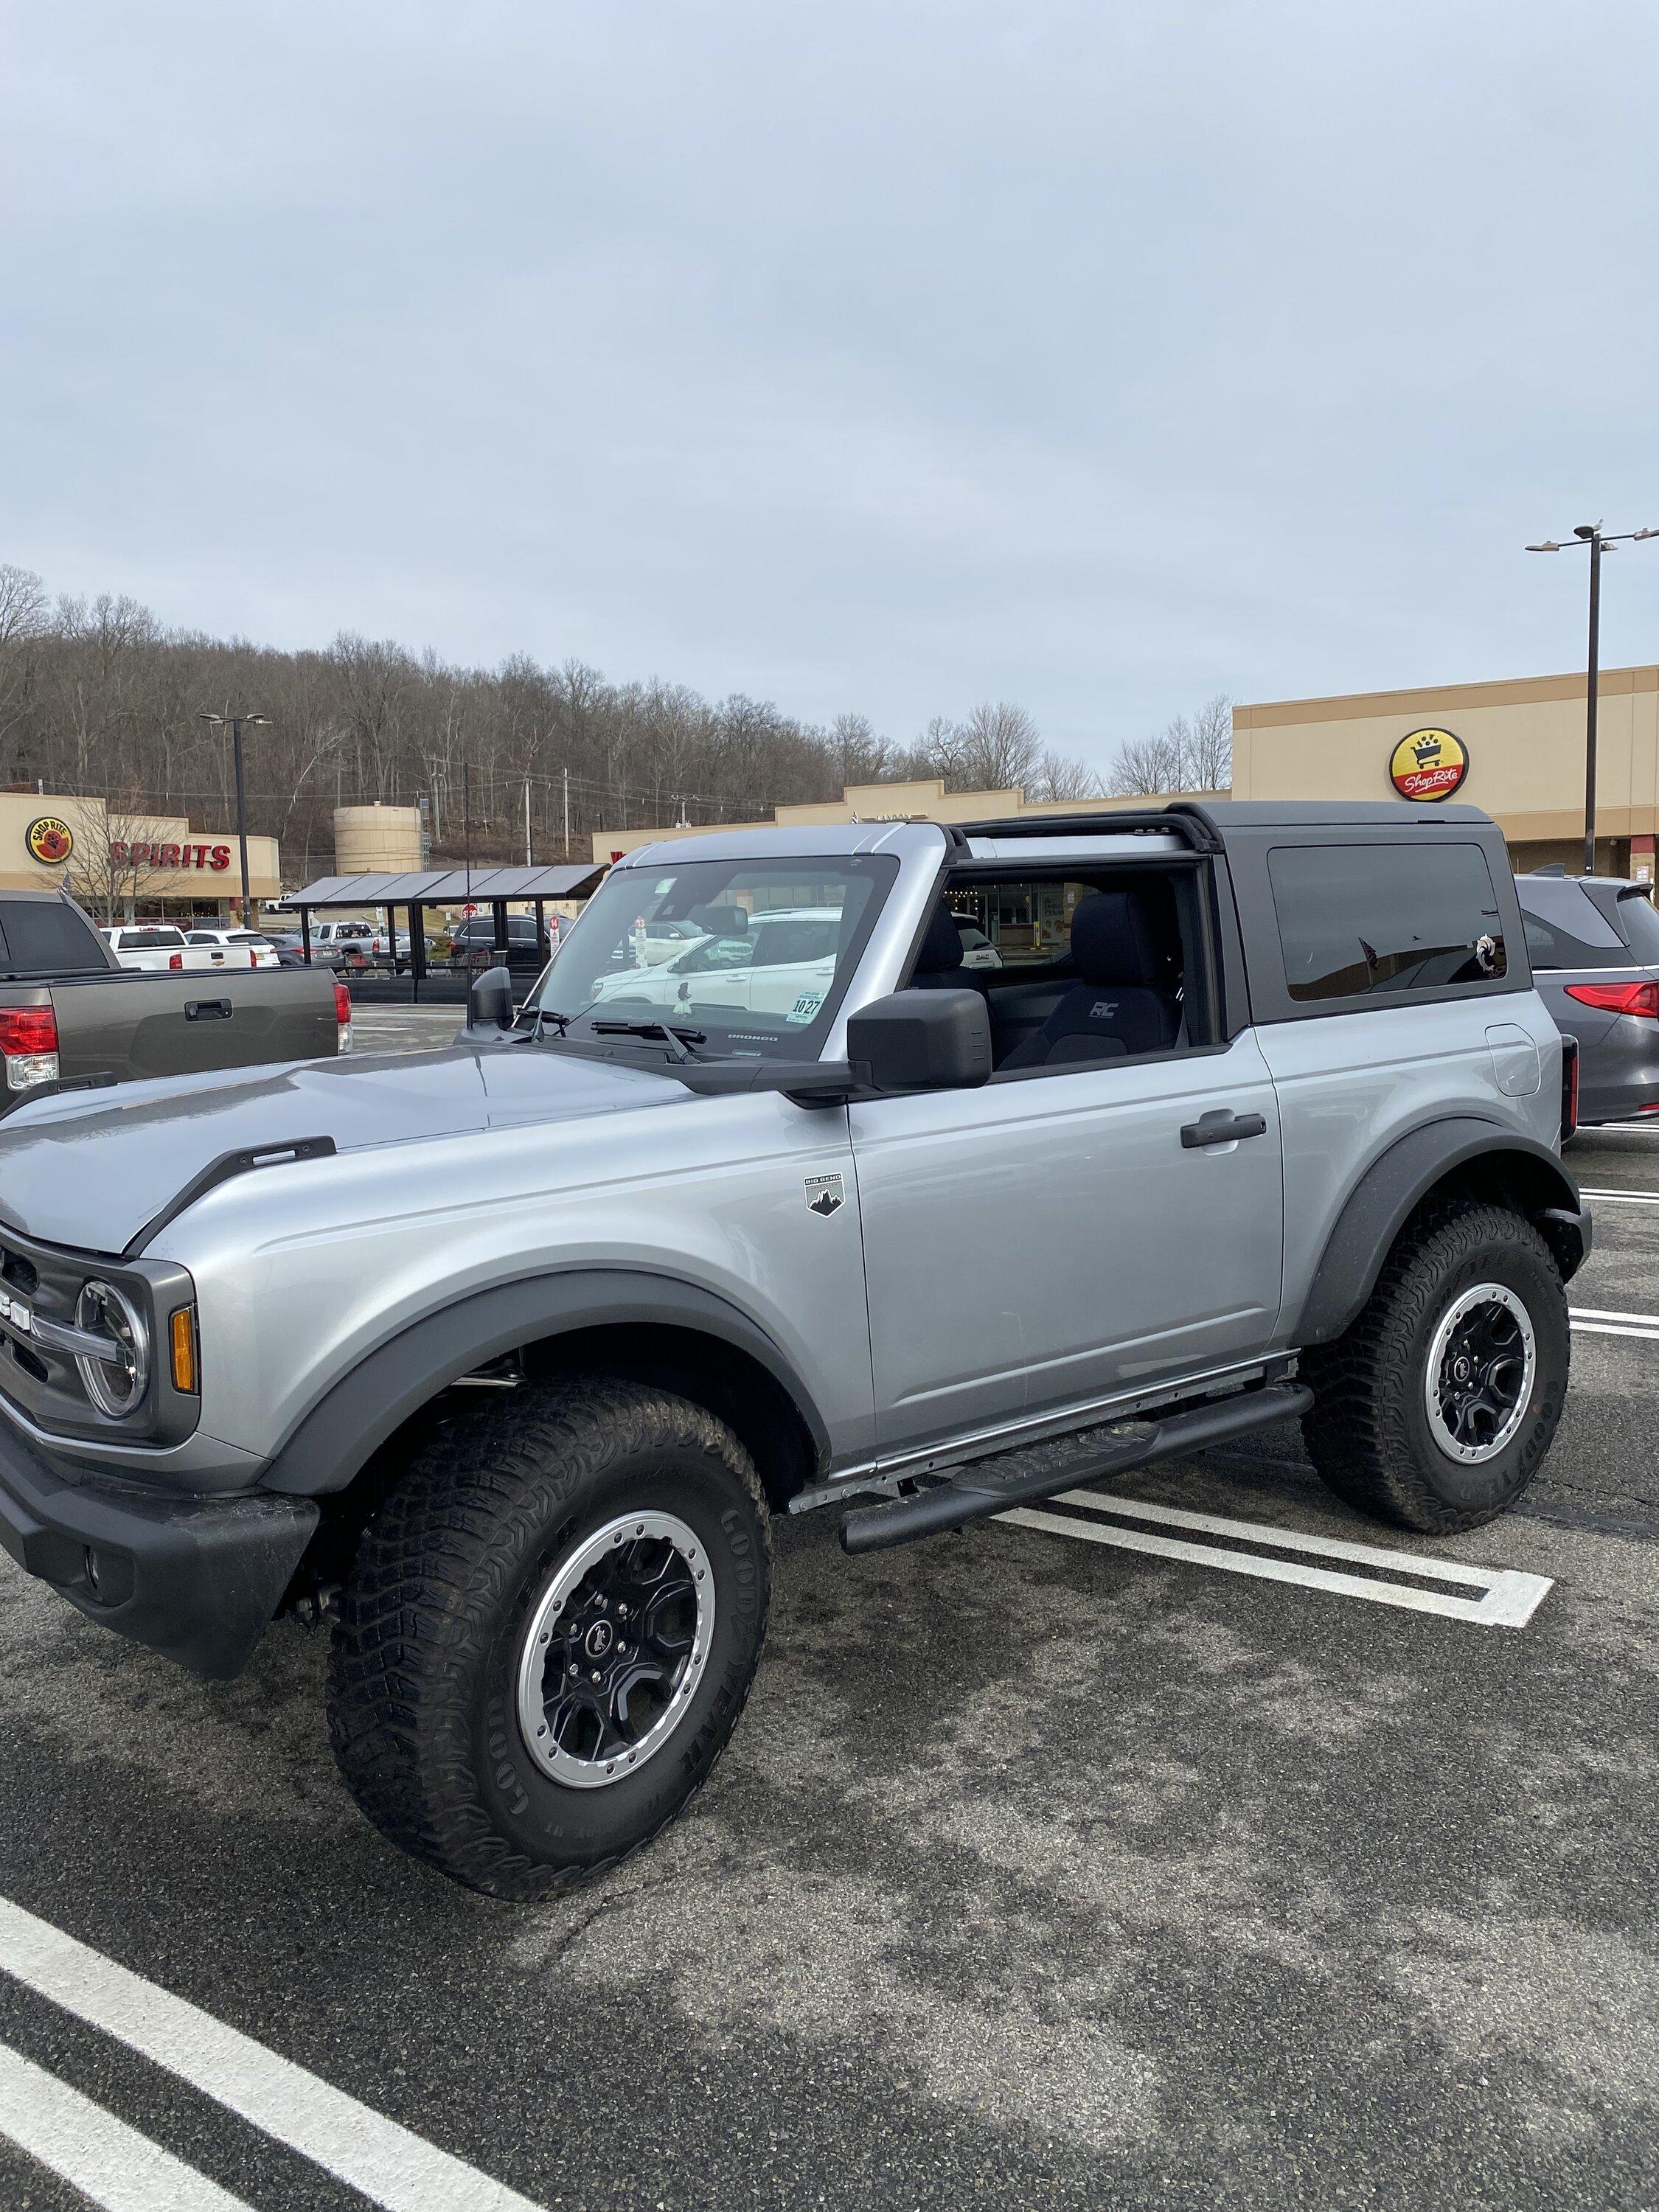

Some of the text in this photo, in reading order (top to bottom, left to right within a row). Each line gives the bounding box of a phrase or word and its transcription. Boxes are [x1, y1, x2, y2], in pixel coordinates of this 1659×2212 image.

[1405, 768, 1458, 793] ShopRite
[32, 821, 67, 841] SHOP RITE
[108, 841, 231, 870] SPIRITS
[550, 919, 557, 928] 14
[636, 919, 645, 928] 13
[793, 1000, 821, 1015] 10 27
[1089, 1001, 1119, 1018] RC
